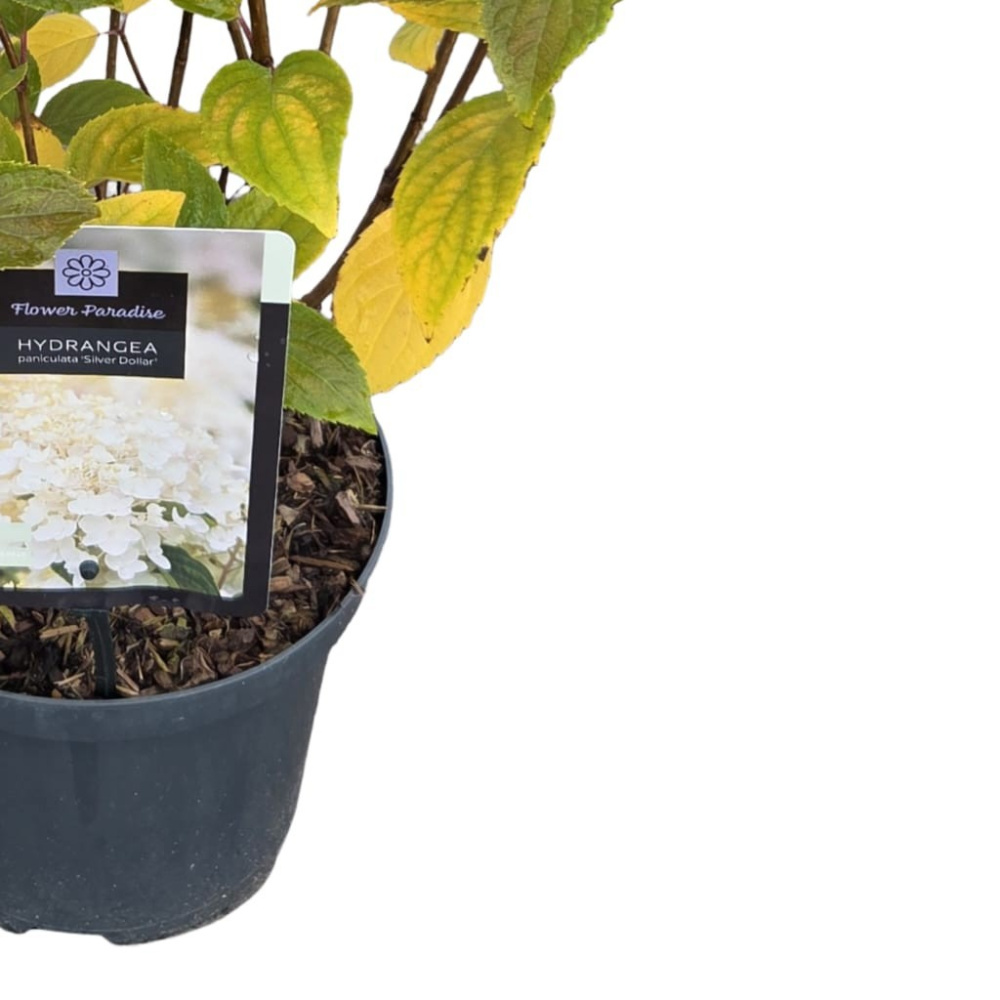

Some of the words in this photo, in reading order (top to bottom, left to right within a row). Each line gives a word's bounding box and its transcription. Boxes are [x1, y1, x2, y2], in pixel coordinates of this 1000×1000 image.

[11, 302, 78, 317] Flower
[81, 304, 166, 319] Paradise
[18, 339, 158, 354] HYDRANGEA
[18, 354, 79, 364] paniculata
